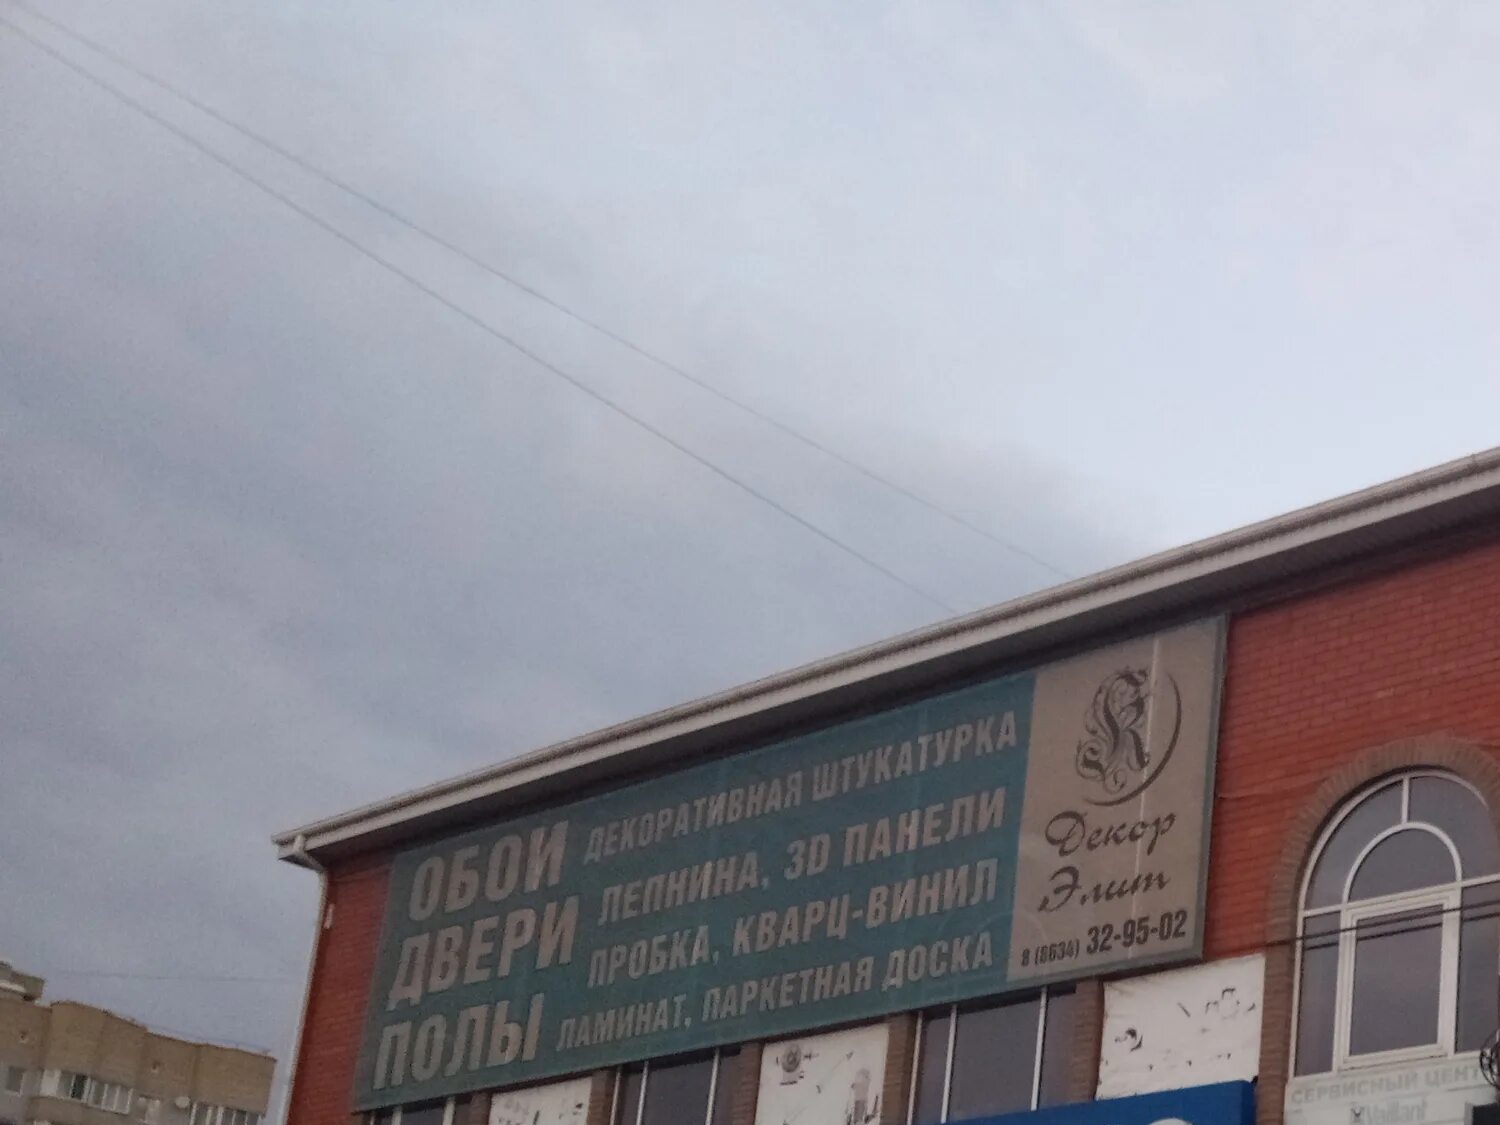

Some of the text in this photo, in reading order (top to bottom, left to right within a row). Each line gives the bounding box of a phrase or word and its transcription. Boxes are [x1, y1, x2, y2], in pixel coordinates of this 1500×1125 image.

[584, 711, 1017, 864] ДЕКОРАТИВНАЯ ШТУКАТУРКА
[1045, 811, 1176, 857] Декор
[409, 821, 568, 921] ОБОИ
[598, 787, 1007, 925] ЛЕПНИНА, 3D ПАНЕЛИ
[1037, 866, 1170, 912] Элит
[387, 896, 578, 1011] ДВЕРИ
[588, 858, 998, 988] ПРОБКА, КВАРЦ-ВИНИЛ
[1086, 910, 1187, 954] 32-95-02
[556, 932, 993, 1051] ЛАМИНАТ, ПАРКЕТНАЯ ДОСКА
[373, 993, 545, 1091] ПОЛЫ
[1291, 1065, 1482, 1104] СЕРВИСНЫЙ ЦЕНТ
